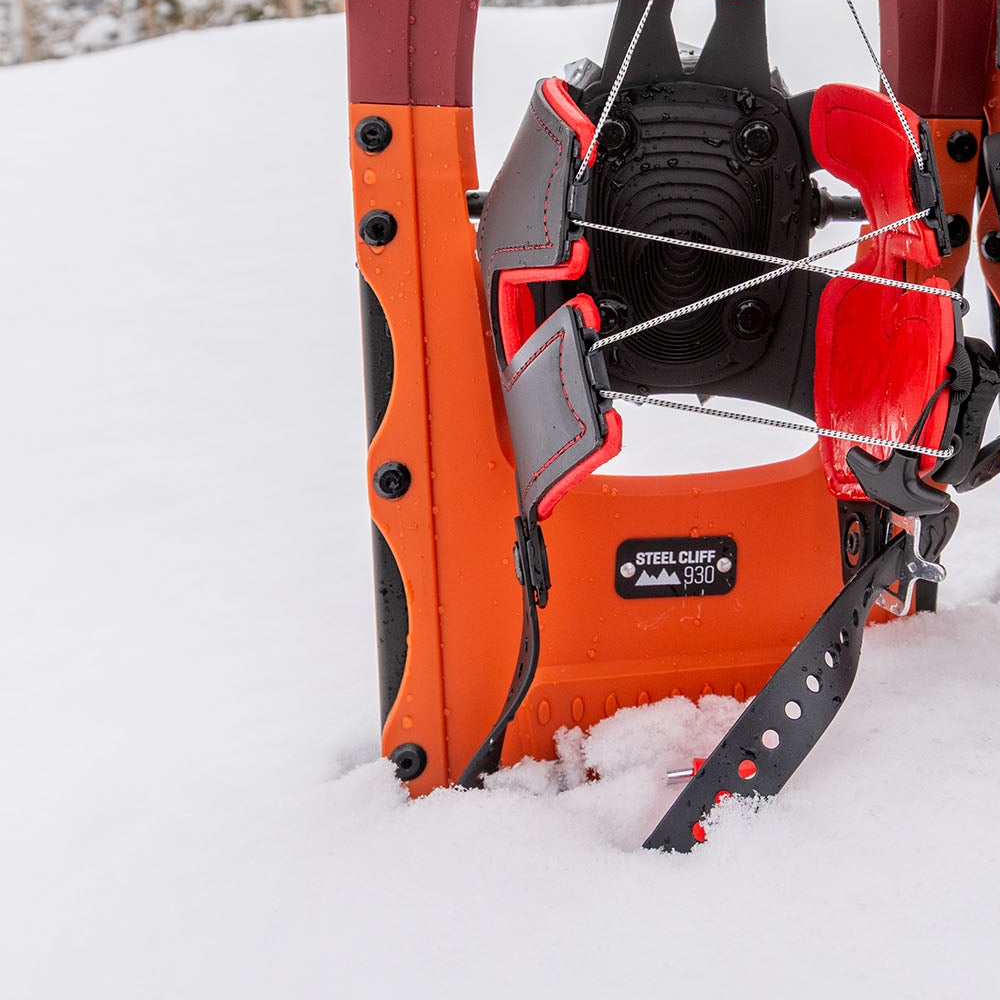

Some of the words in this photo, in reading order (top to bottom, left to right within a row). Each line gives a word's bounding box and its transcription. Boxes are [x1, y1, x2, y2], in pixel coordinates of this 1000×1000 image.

[636, 551, 677, 566] STEEL
[678, 550, 716, 564] CLIFF
[683, 565, 715, 584] 930
